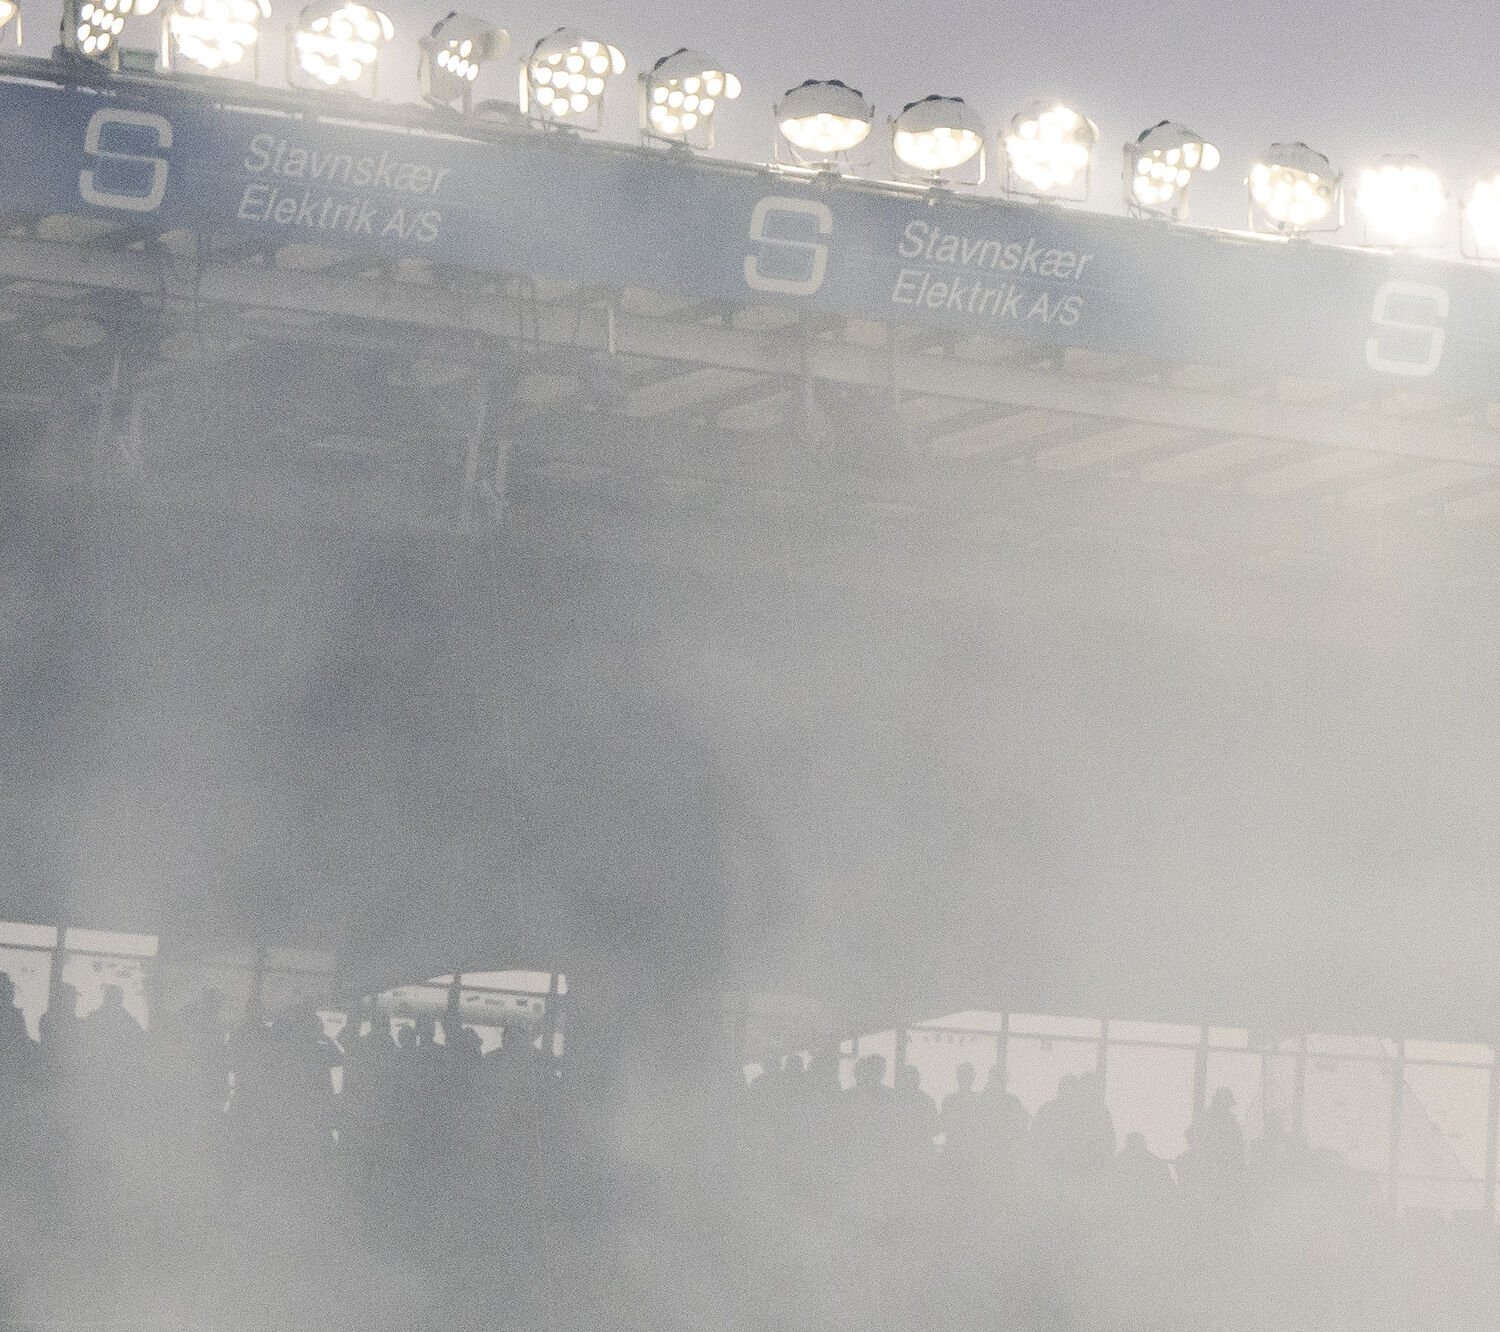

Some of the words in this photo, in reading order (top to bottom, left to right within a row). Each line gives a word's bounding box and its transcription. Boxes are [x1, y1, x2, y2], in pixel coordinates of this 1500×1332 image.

[243, 134, 451, 194] Stavnskær
[237, 185, 375, 233] Elektrik
[382, 208, 443, 242] A/S
[897, 219, 1093, 280] Stavnskær
[891, 270, 1019, 320] Elektrik
[1025, 292, 1083, 328] A/S
